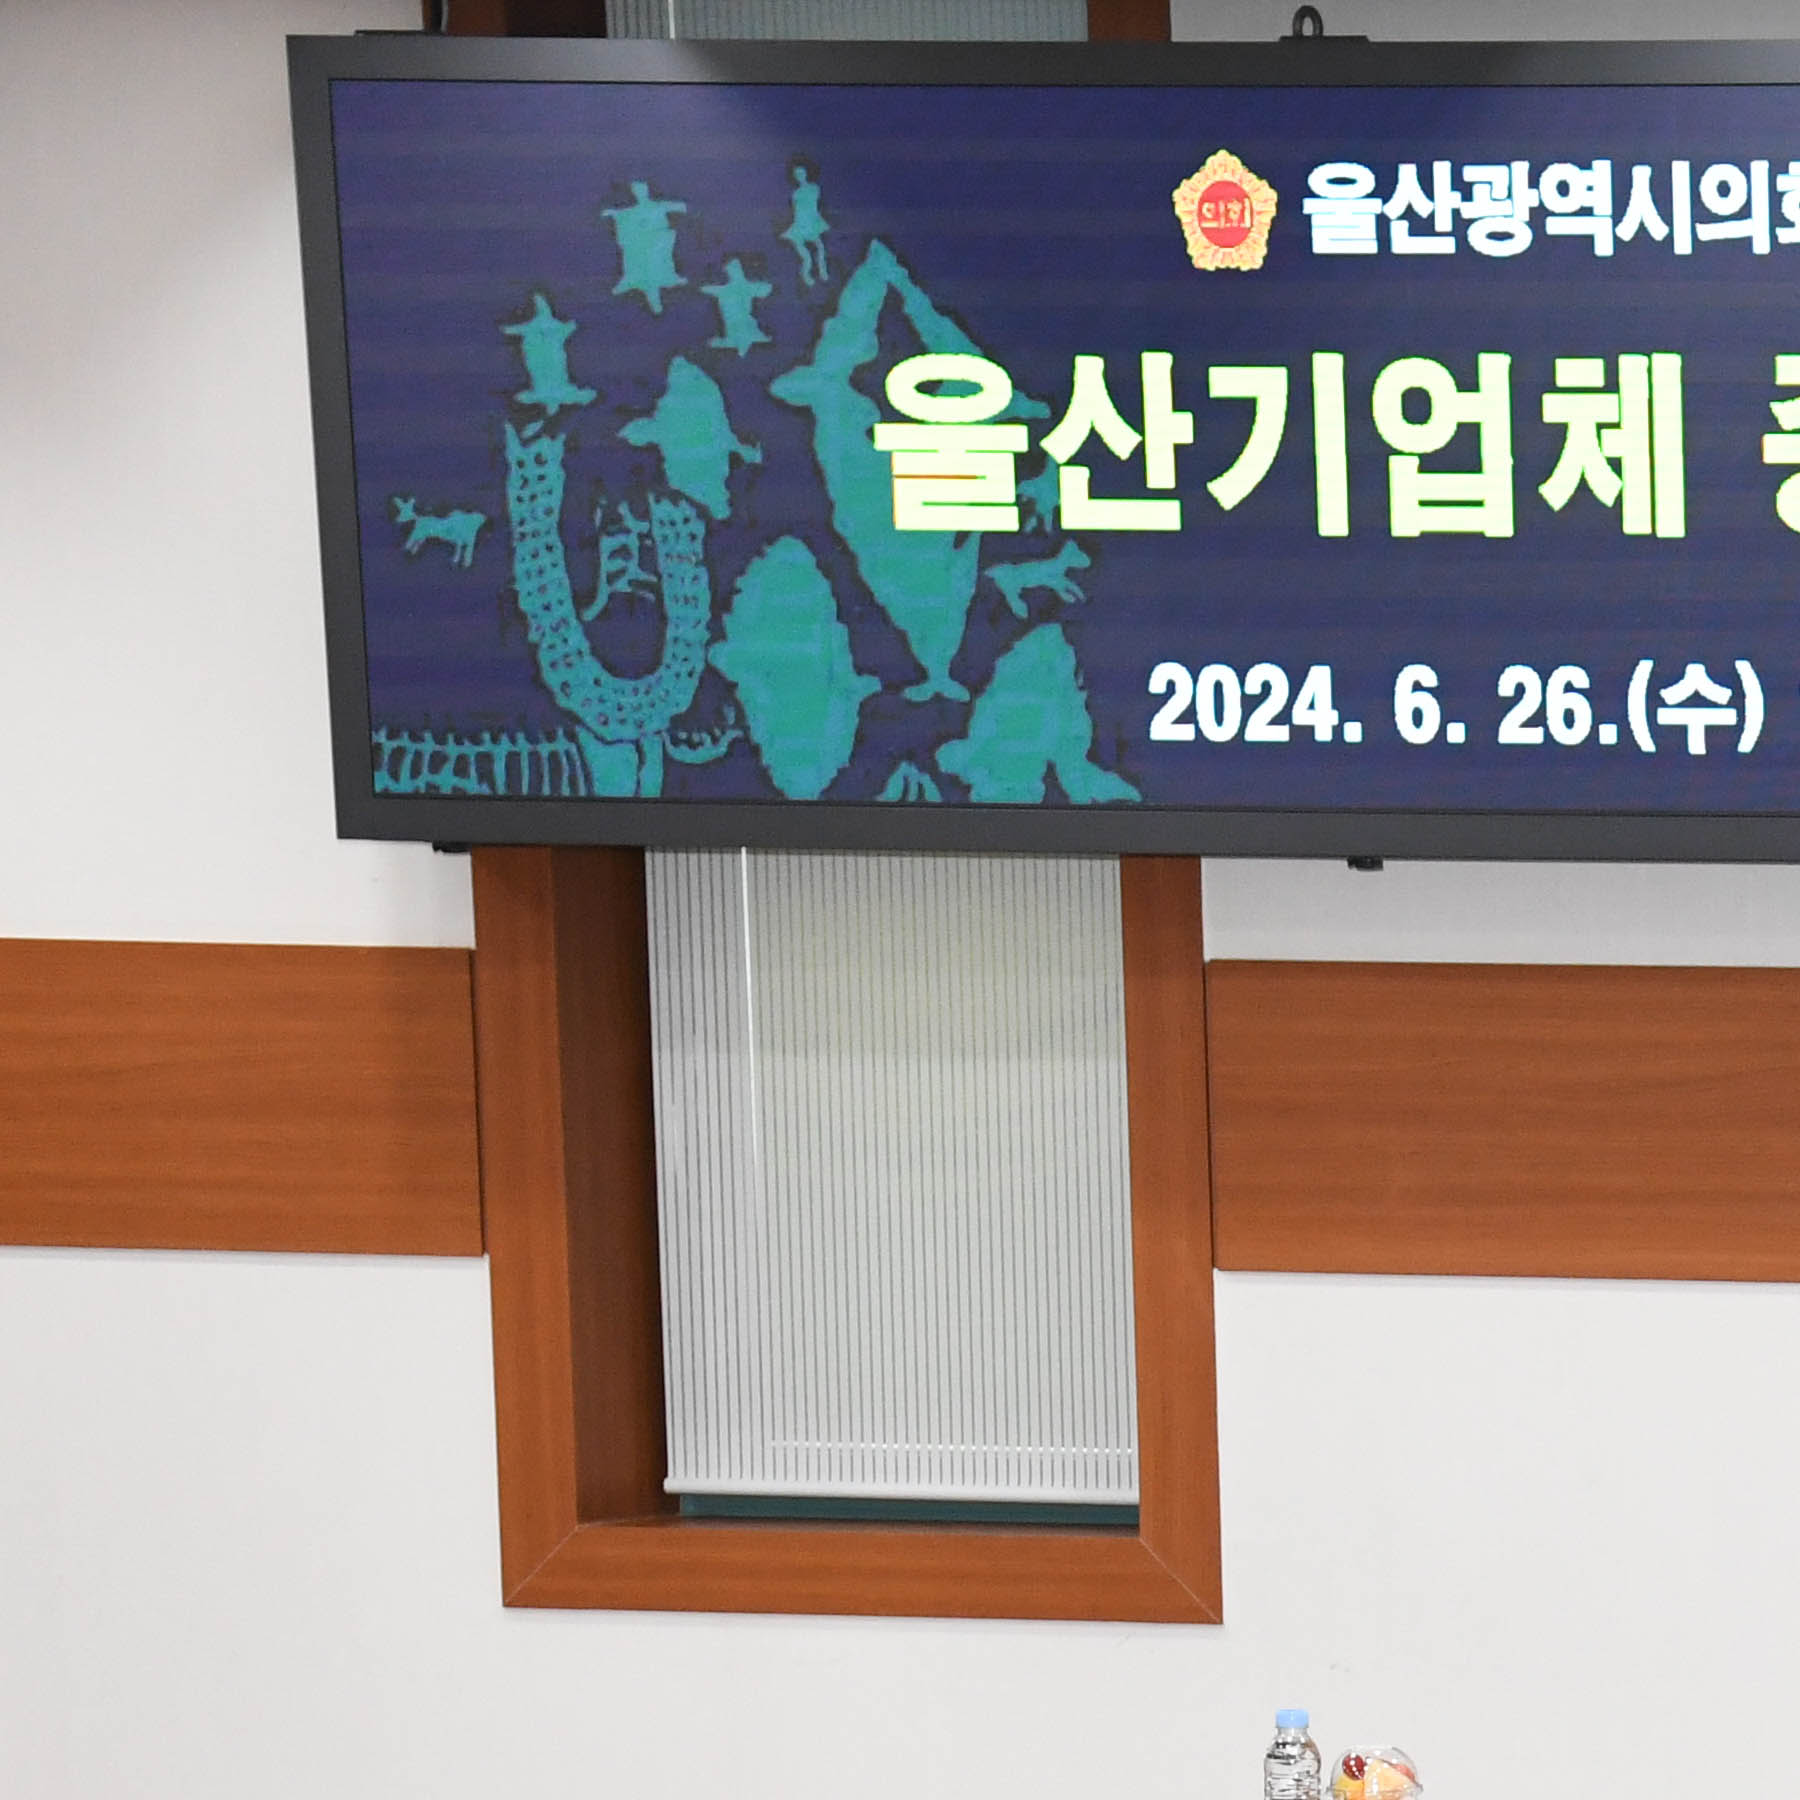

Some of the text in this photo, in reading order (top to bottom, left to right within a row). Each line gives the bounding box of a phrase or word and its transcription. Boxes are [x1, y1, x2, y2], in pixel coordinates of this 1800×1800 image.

[873, 351, 1686, 539] 울산기업체
[1147, 661, 1363, 744] 2024.
[1393, 663, 1467, 745] 6.
[1496, 659, 1765, 756] 26.(수)
